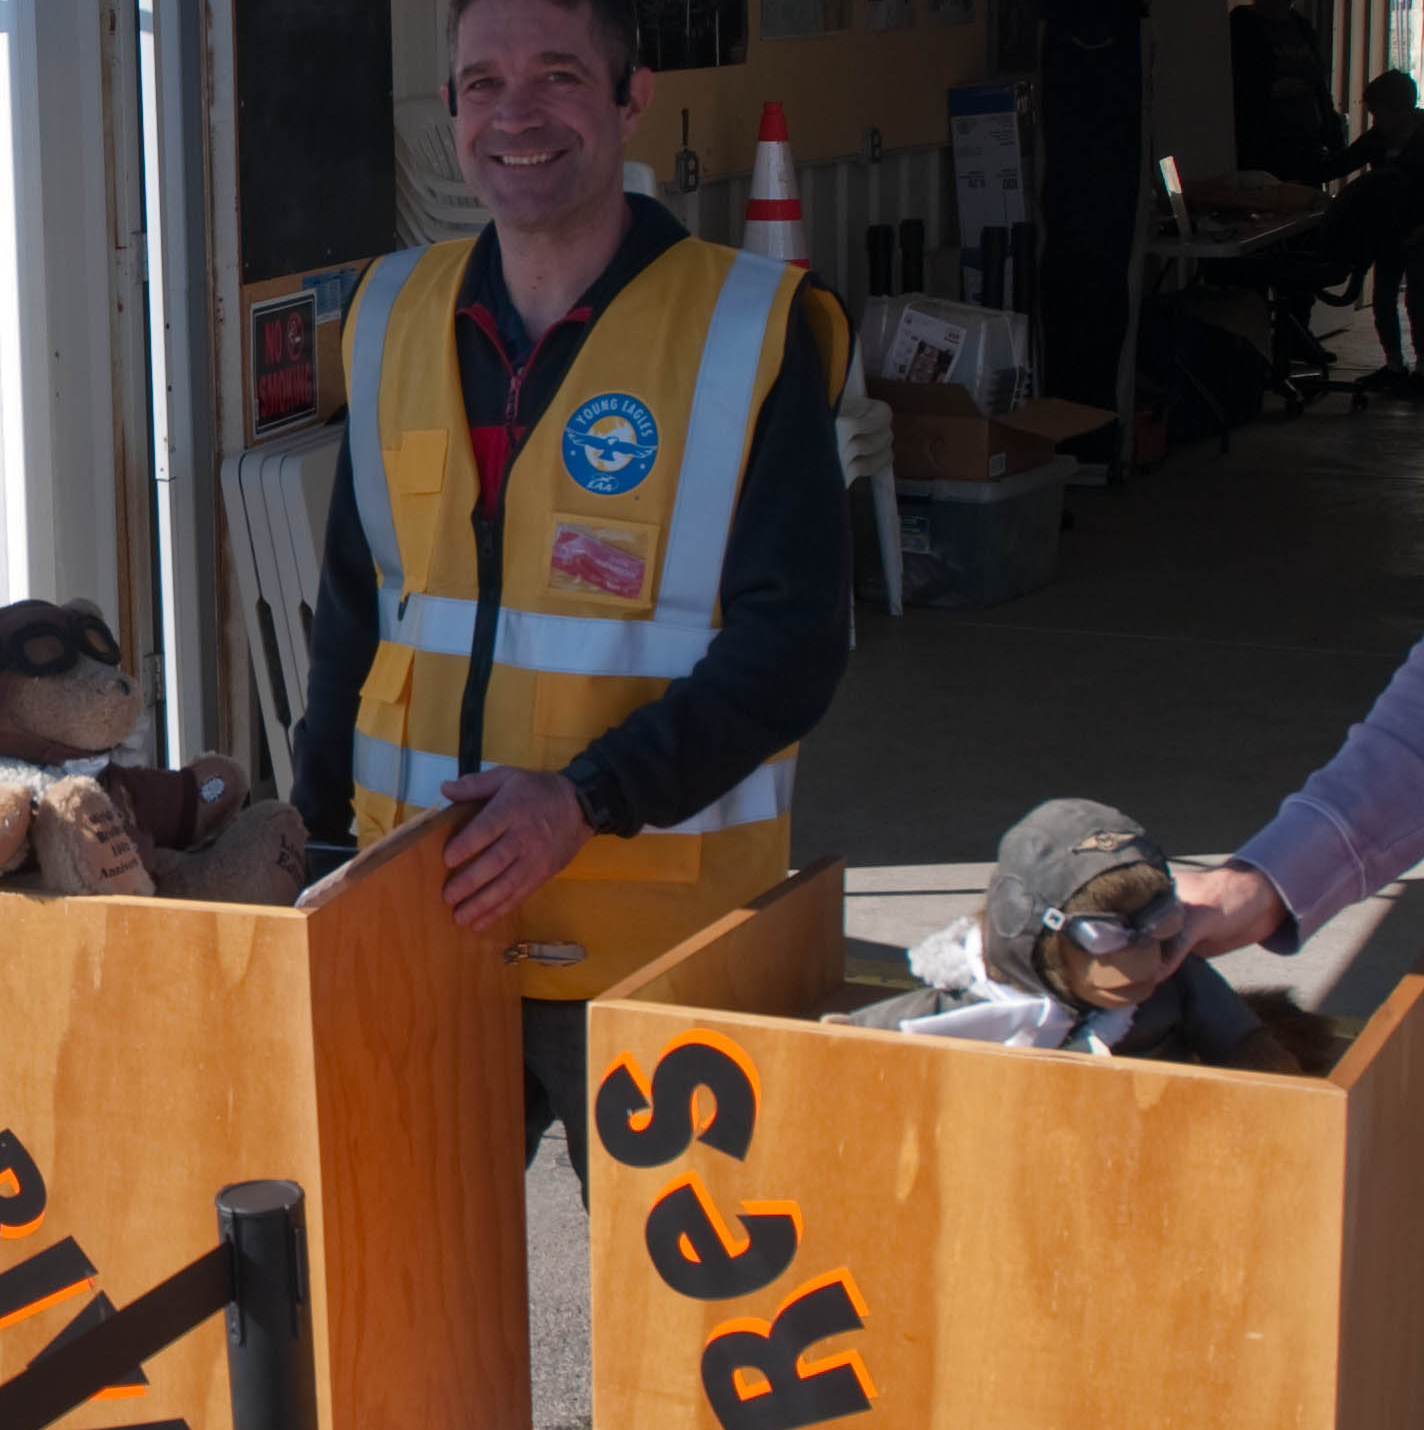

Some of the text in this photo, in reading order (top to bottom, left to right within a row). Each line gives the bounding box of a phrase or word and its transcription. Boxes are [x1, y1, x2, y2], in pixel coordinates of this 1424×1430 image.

[264, 317, 282, 365] NO
[258, 362, 314, 419] SMOKING
[576, 398, 654, 438] YOUNG EAGLES
